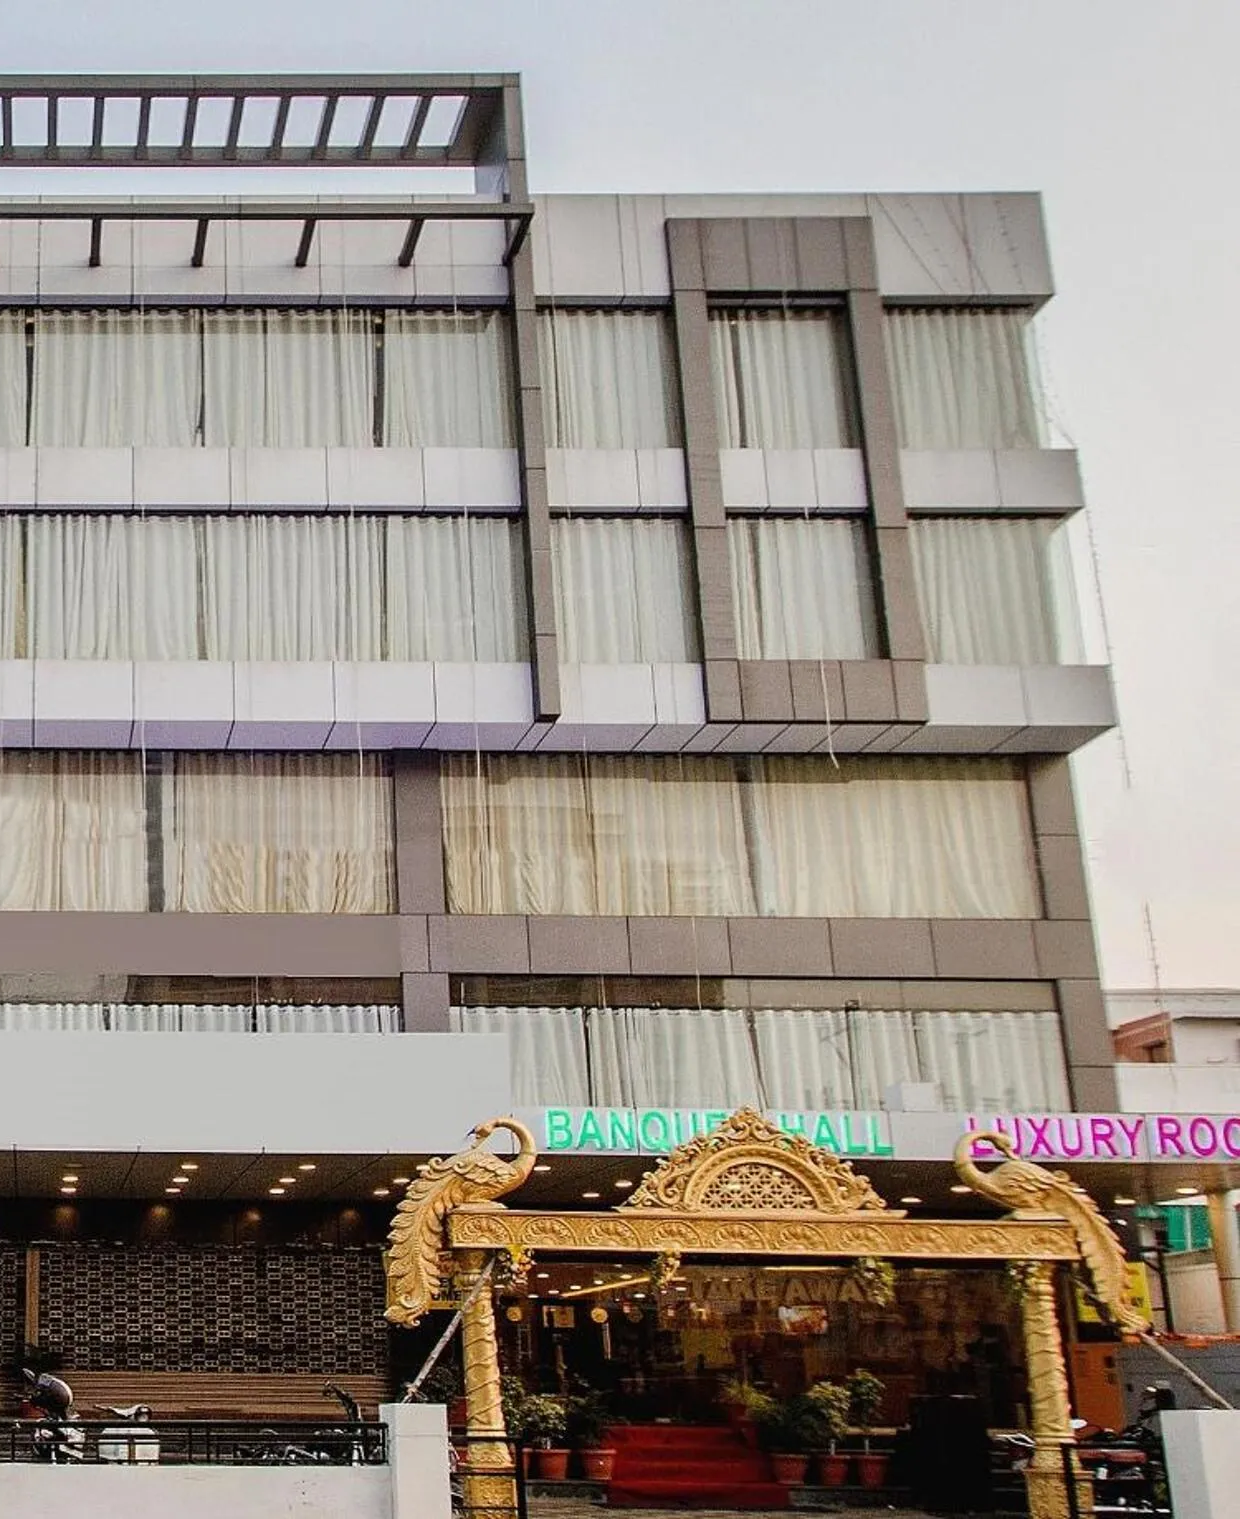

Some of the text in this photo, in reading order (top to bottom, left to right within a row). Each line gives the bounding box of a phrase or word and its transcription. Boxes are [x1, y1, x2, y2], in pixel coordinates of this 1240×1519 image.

[545, 1109, 895, 1155] BANQUE HALL
[966, 1116, 1145, 1157] LUXURY
